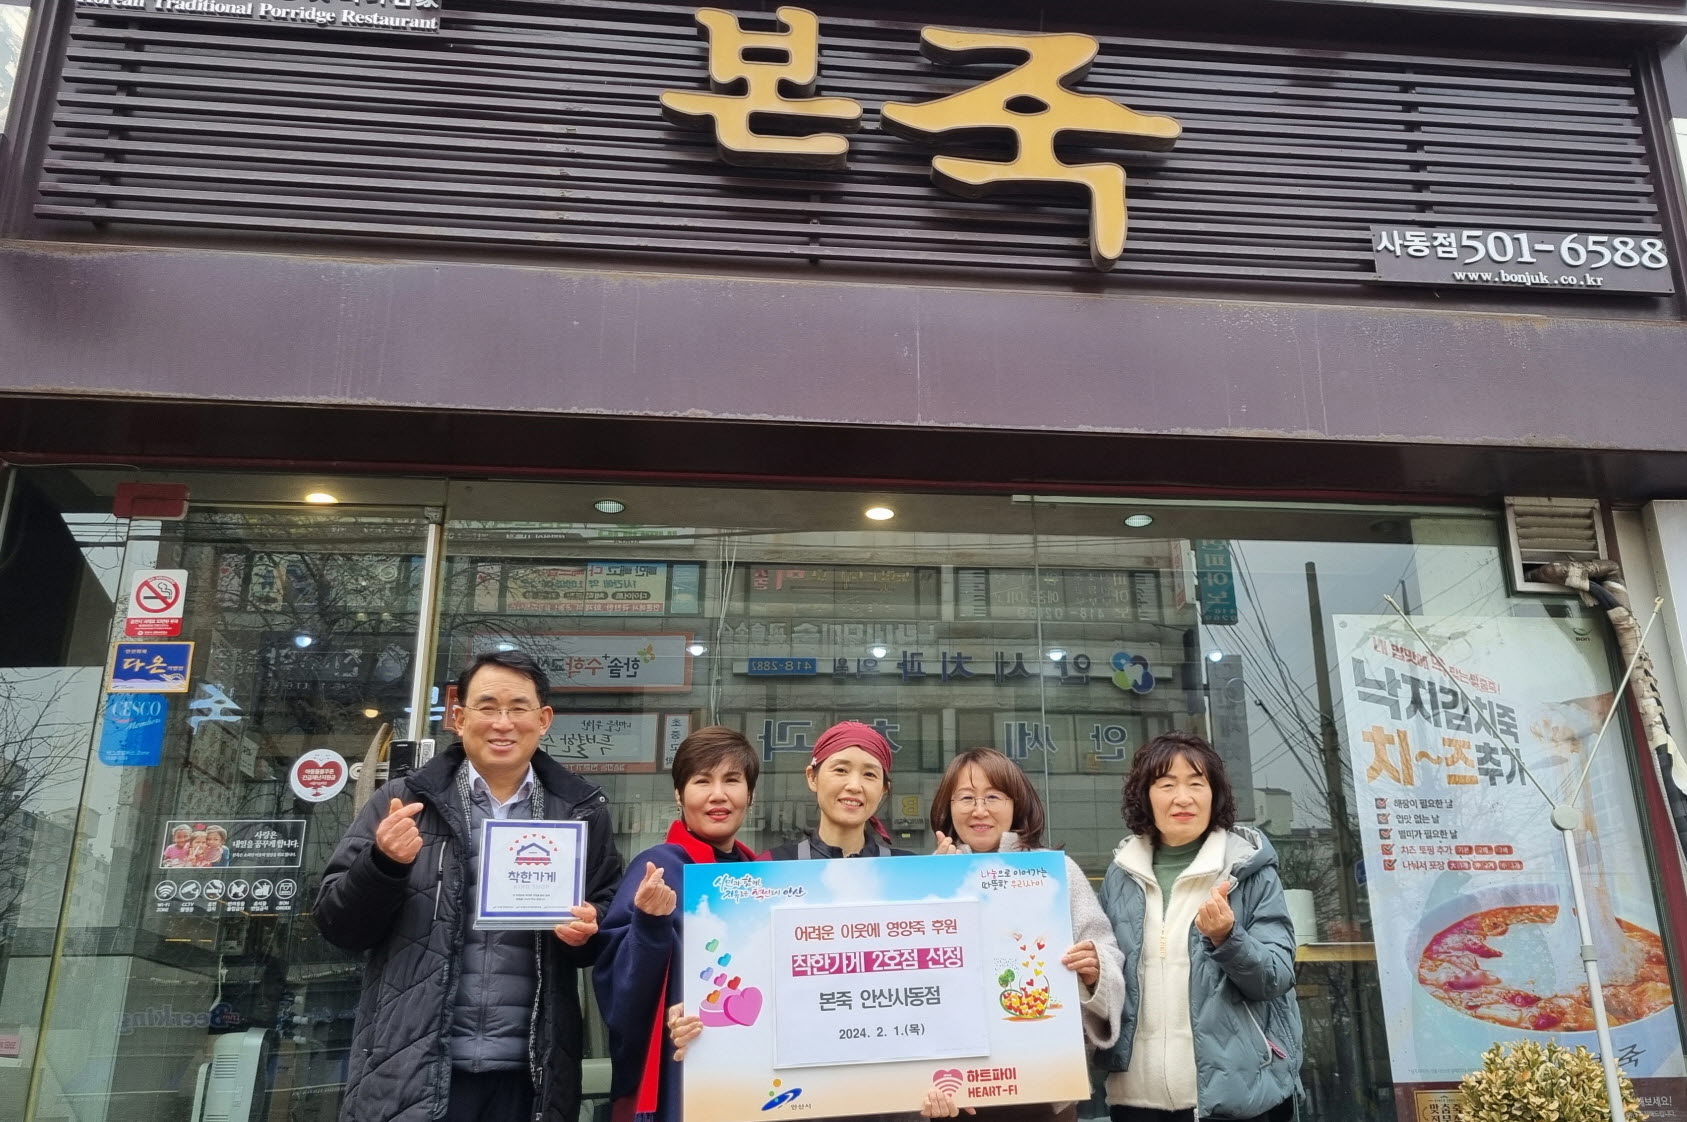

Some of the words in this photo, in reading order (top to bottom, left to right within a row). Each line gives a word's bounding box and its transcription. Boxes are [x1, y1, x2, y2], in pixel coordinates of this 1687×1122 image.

[154, 0, 251, 15] Traditional
[259, 2, 336, 25] Porridge
[341, 9, 439, 30] Restaurant
[660, 5, 1183, 271] 본죽
[1377, 229, 1459, 259] 사동점
[1460, 229, 1669, 269] 501-6588
[1453, 269, 1603, 287] www.bonjuk.co.kr
[1351, 656, 1519, 744] 낙지김치죽
[112, 700, 162, 717] CESCO
[1419, 798, 1443, 809] 필요한
[1444, 799, 1453, 809] 날
[1396, 814, 1412, 824] 입맛
[1413, 814, 1431, 824] 없는
[1431, 814, 1440, 824] 날
[254, 830, 278, 839] 사랑은
[1398, 829, 1422, 840] 별미가
[1423, 829, 1448, 839] 필요한
[1449, 829, 1458, 839] 날
[232, 839, 253, 849] 내일을
[254, 839, 277, 849] 꿈꾸게
[277, 839, 299, 849] 합니다.
[1401, 845, 1416, 854] 치즈
[1419, 845, 1435, 854] 토핑
[1436, 845, 1452, 854] 추가
[1013, 866, 1047, 878] 이어가는
[1428, 860, 1445, 870] 포장
[508, 870, 557, 884] 착한가게
[981, 879, 1008, 890] 따뜻한
[1011, 880, 1044, 888] 우리사이
[783, 886, 806, 898] 안산
[795, 925, 835, 941] 어려운
[841, 922, 880, 939] 이웃에
[886, 920, 926, 937] 영양죽
[931, 918, 957, 935] 후원
[793, 951, 866, 976] 착한가게
[872, 948, 919, 971] 2호점
[926, 946, 963, 969] 선정
[819, 990, 853, 1012] 본죽
[860, 985, 941, 1009] 안산사동점
[838, 1027, 871, 1040] 2024.
[876, 1026, 887, 1038] 2.
[894, 1023, 926, 1037] 1.(목)
[966, 1067, 1017, 1083] 하트파이
[967, 1084, 1018, 1099] HEART-FI
[791, 1103, 812, 1111] 안산시
